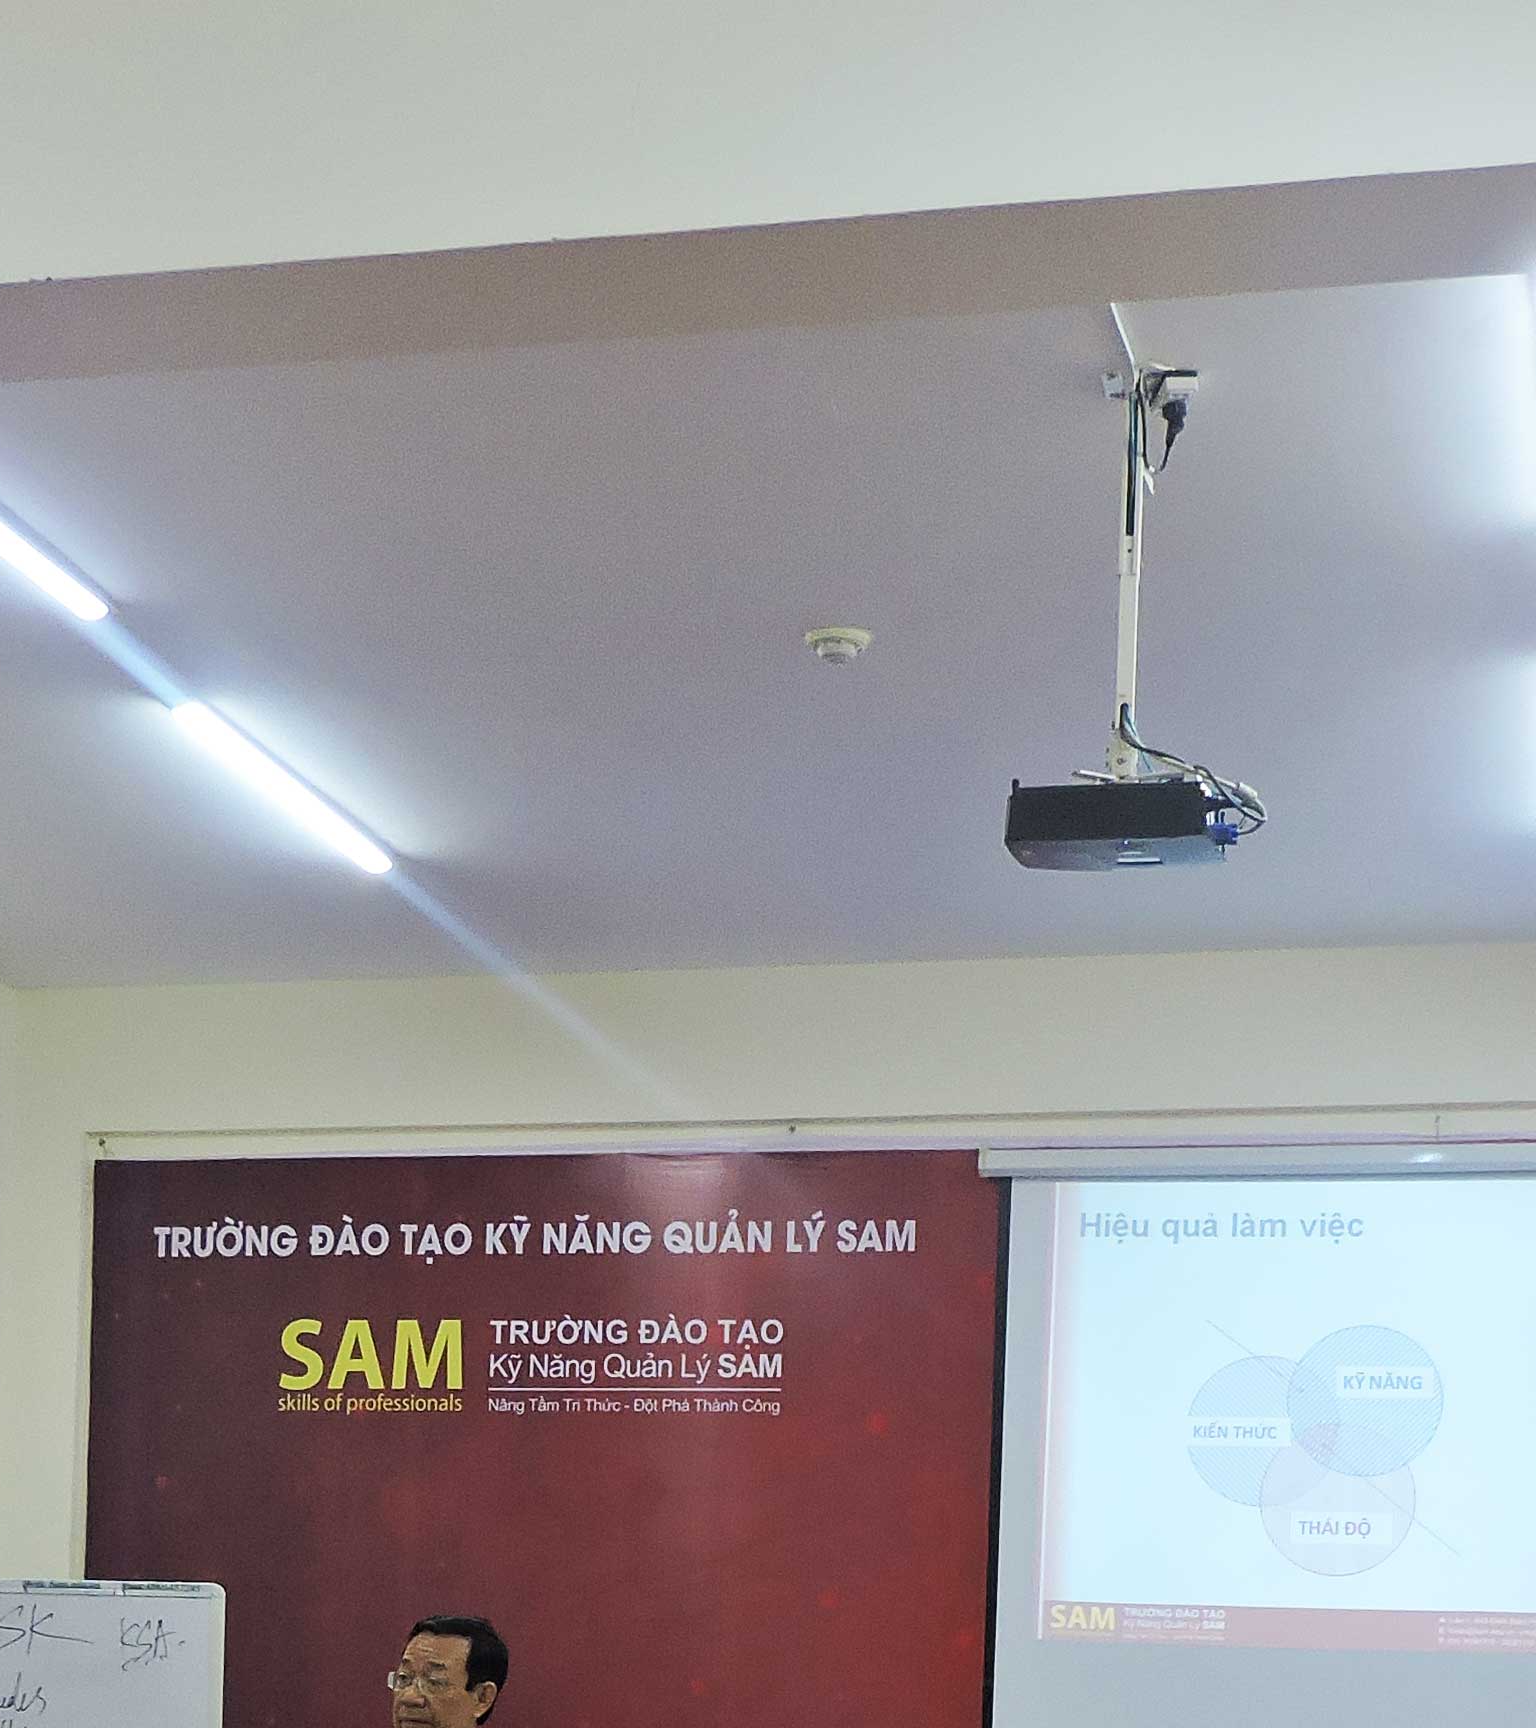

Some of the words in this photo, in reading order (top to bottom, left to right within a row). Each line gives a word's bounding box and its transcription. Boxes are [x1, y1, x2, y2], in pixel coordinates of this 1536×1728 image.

[154, 1216, 298, 1258] TRƯỜNG
[309, 1215, 389, 1257] ĐÀO
[400, 1223, 473, 1265] TẠO
[485, 1215, 531, 1256] KỸ
[542, 1214, 652, 1254] NĂNG
[663, 1208, 772, 1254] QUẢN
[786, 1210, 826, 1253] LÝ
[837, 1219, 916, 1254] SAM
[1080, 1211, 1150, 1244] Hiệu
[1162, 1212, 1218, 1244] quả
[1231, 1212, 1287, 1238] làm
[1300, 1212, 1364, 1244] việc
[489, 1314, 628, 1345] TRƯỜNG
[638, 1313, 708, 1345] ĐÀO
[717, 1319, 784, 1350] TẠO
[279, 1318, 463, 1391] SAM
[489, 1353, 523, 1384] Kỹ
[529, 1353, 596, 1384] Năng
[603, 1352, 673, 1379] Quản
[680, 1353, 711, 1384] Lý
[717, 1353, 783, 1379] SAM
[1369, 1371, 1424, 1390] NĂNG
[277, 1393, 320, 1412] skills
[324, 1393, 344, 1412] of
[346, 1393, 463, 1415] professionals
[1297, 1517, 1339, 1536] THÁI
[1343, 1517, 1371, 1539] ĐỘ
[1050, 1604, 1116, 1631] SAM
